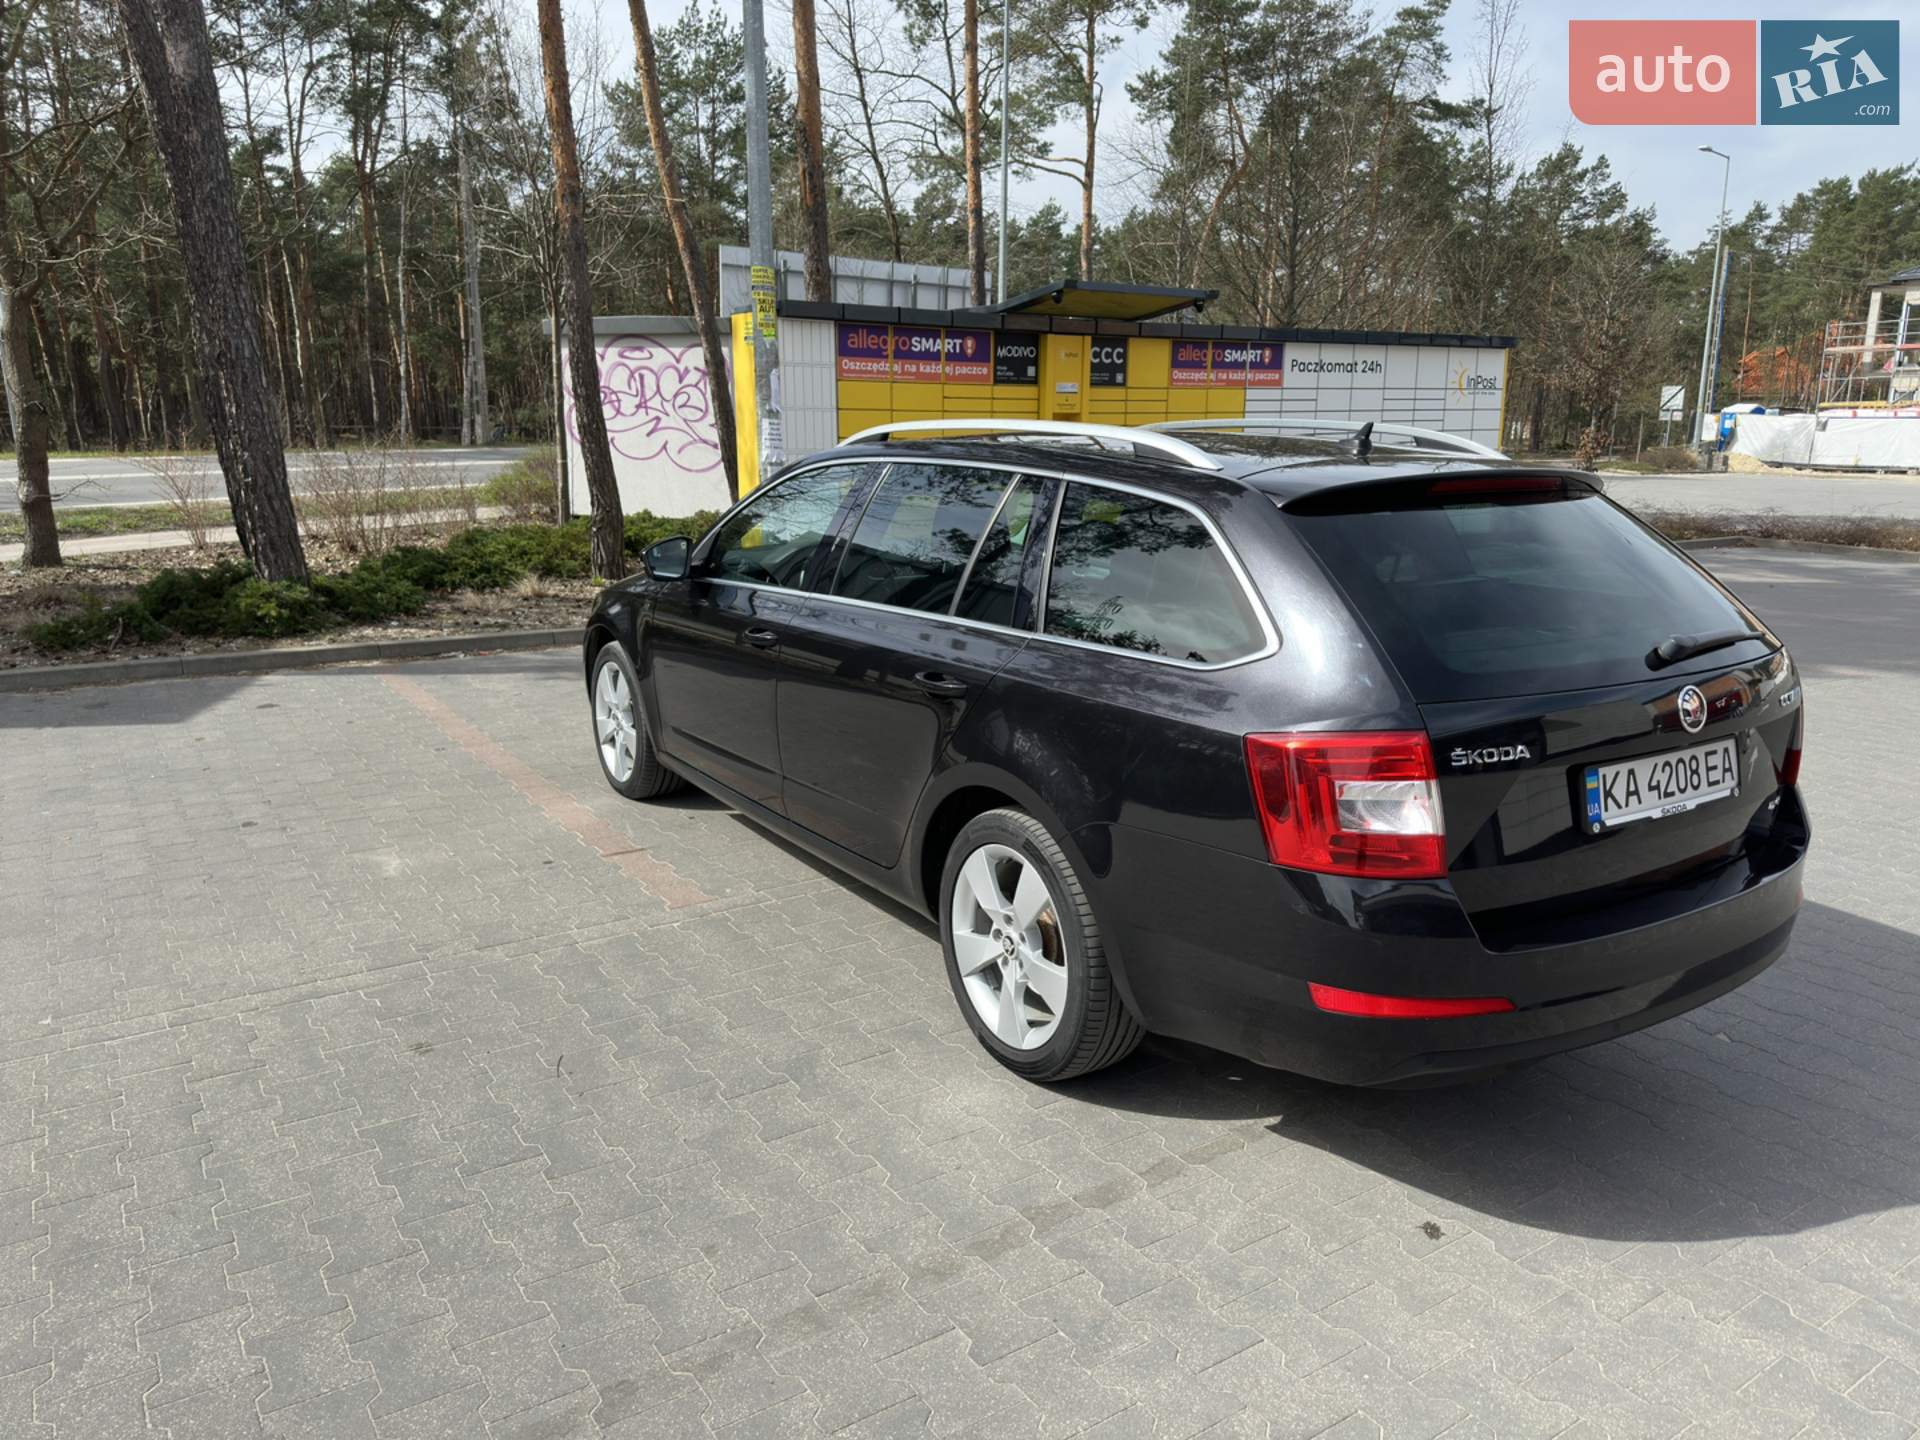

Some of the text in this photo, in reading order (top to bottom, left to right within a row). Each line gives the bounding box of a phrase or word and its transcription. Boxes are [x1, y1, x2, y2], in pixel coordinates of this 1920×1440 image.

[996, 345, 1036, 358] MODIVO
[1090, 346, 1124, 364] CCC
[904, 363, 917, 373] na
[920, 362, 954, 376] każdej
[1290, 358, 1382, 374] Paczkomat 24h
[1217, 372, 1227, 380] na
[1467, 374, 1497, 389] InPost
[1451, 745, 1531, 766] ŠKODA
[1587, 747, 1735, 816] UA KA 4208 EA
[1661, 803, 1688, 817] ŠKODA
